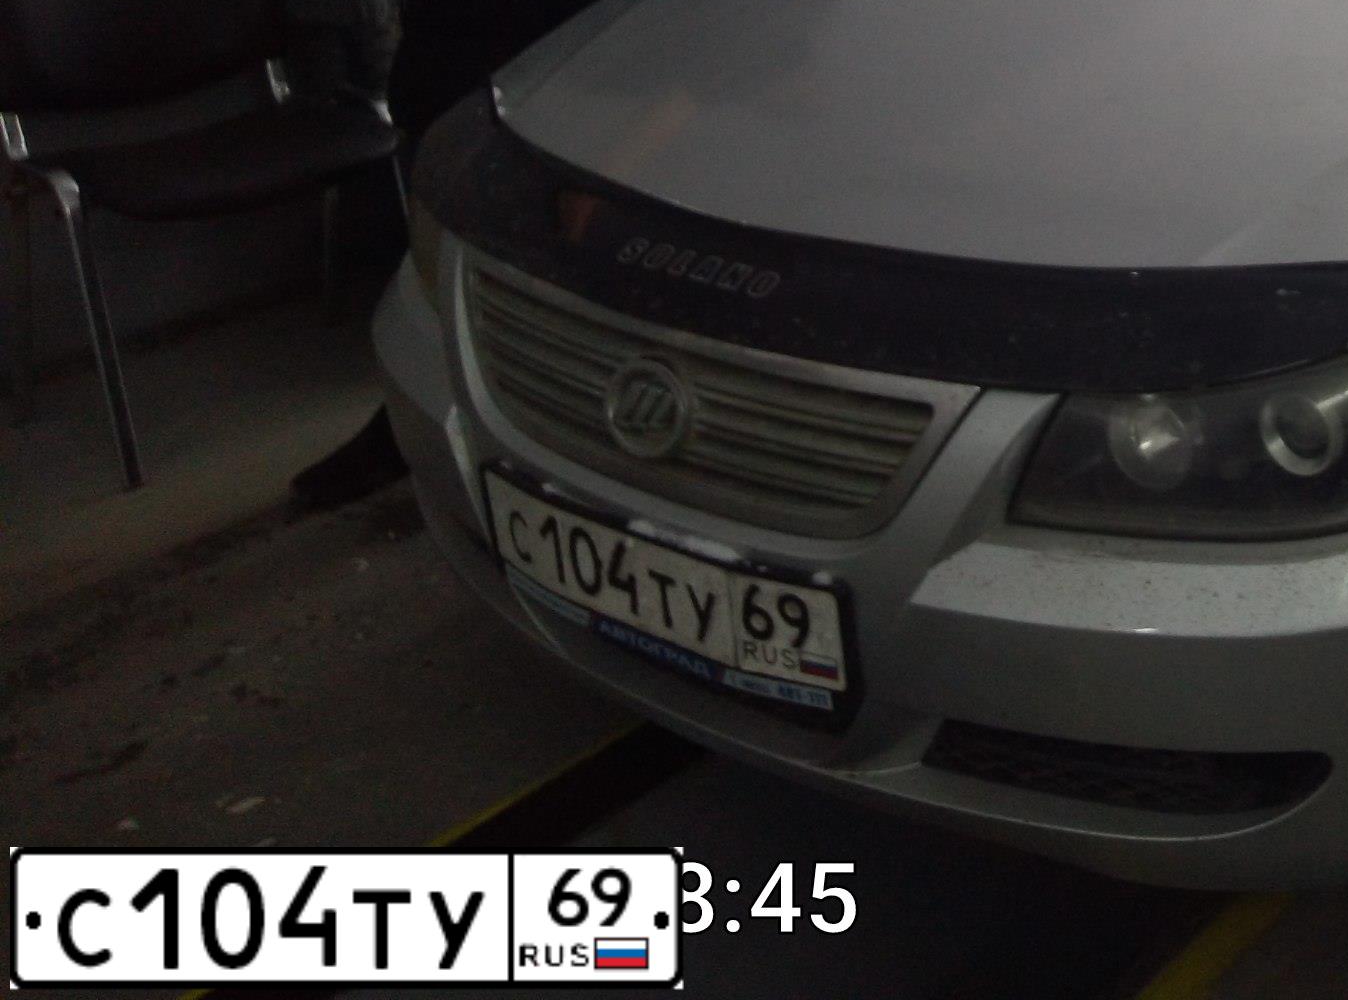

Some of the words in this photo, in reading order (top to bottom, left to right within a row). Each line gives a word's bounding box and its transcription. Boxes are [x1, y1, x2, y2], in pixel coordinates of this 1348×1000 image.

[615, 236, 782, 298] SOLANO
[509, 510, 716, 640] С104ТУ
[742, 583, 810, 648] 69
[742, 642, 797, 671] RUS
